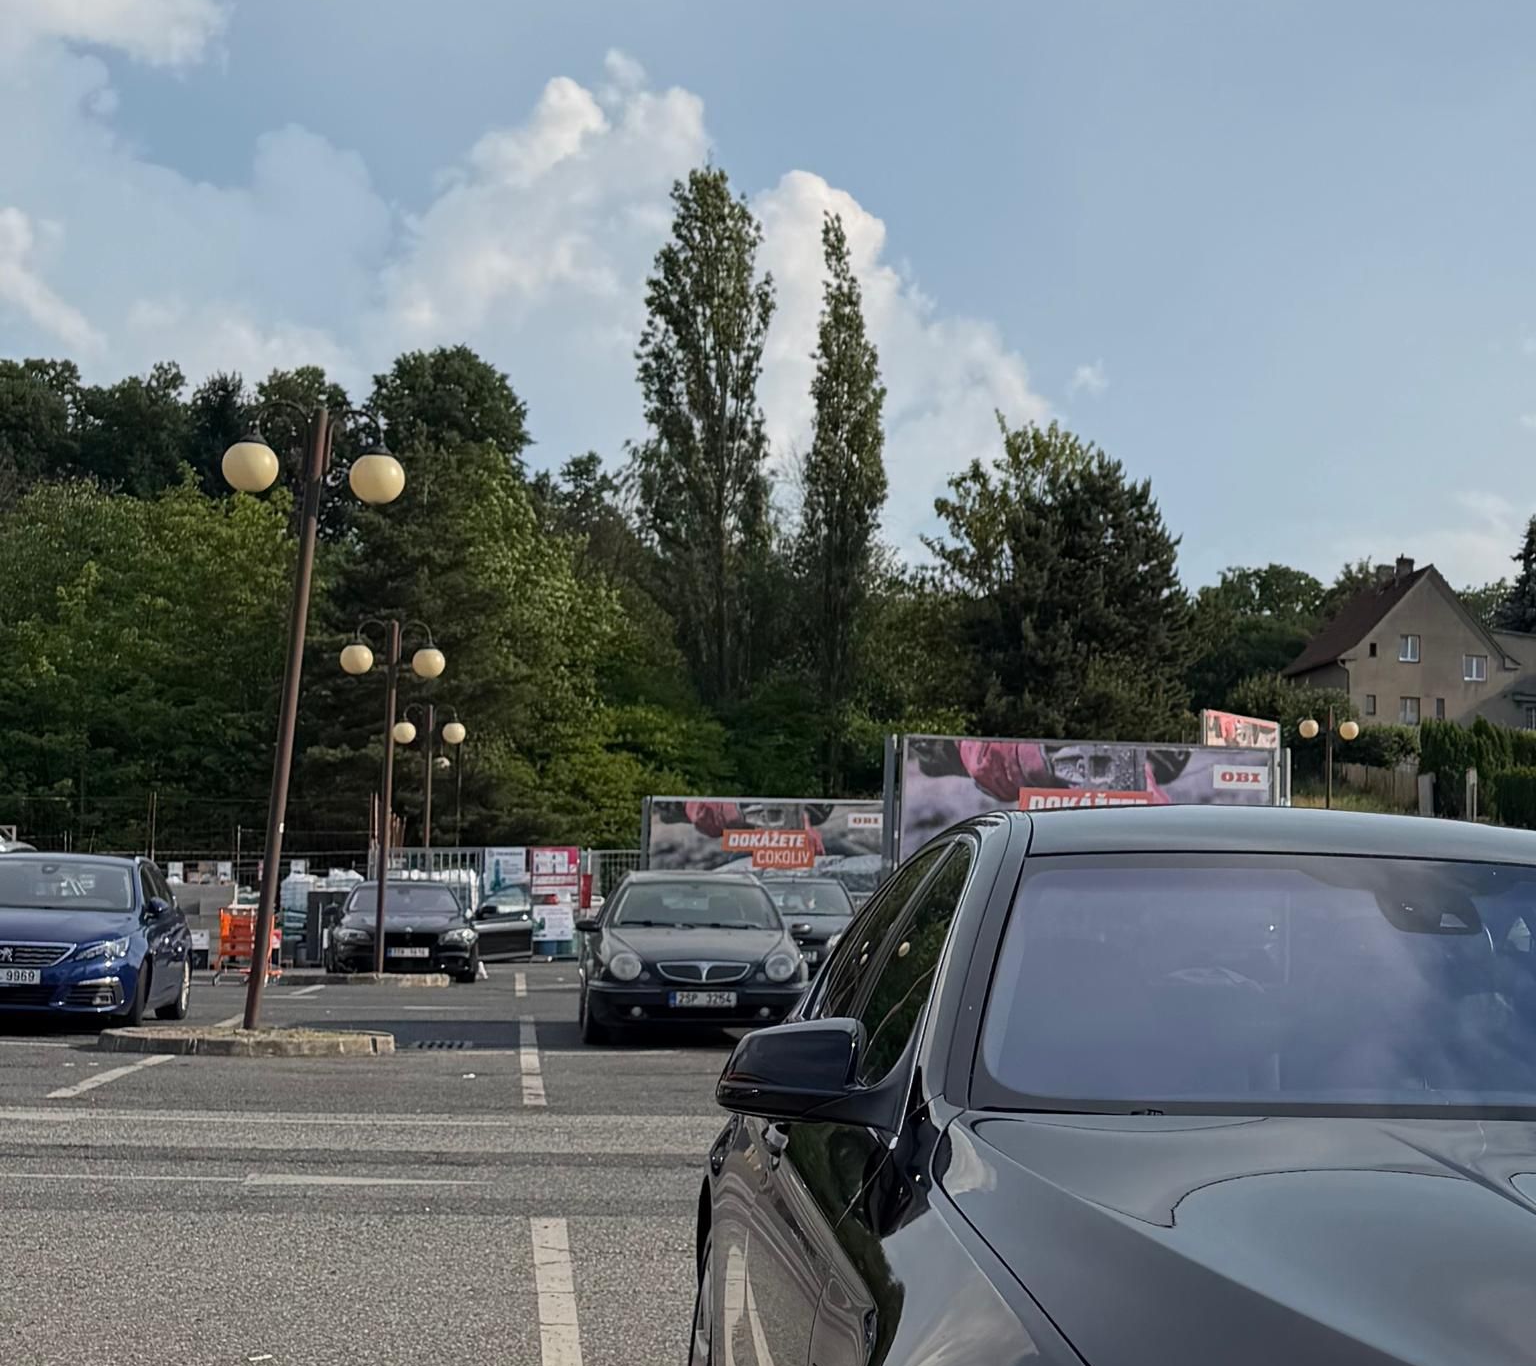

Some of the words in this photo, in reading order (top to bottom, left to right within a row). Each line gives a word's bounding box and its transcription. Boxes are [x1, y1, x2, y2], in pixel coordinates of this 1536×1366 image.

[1221, 771, 1261, 783] OBI
[852, 817, 879, 825] OBI
[728, 830, 806, 848] DOKÁŽETE
[756, 849, 810, 865] COKOLIV
